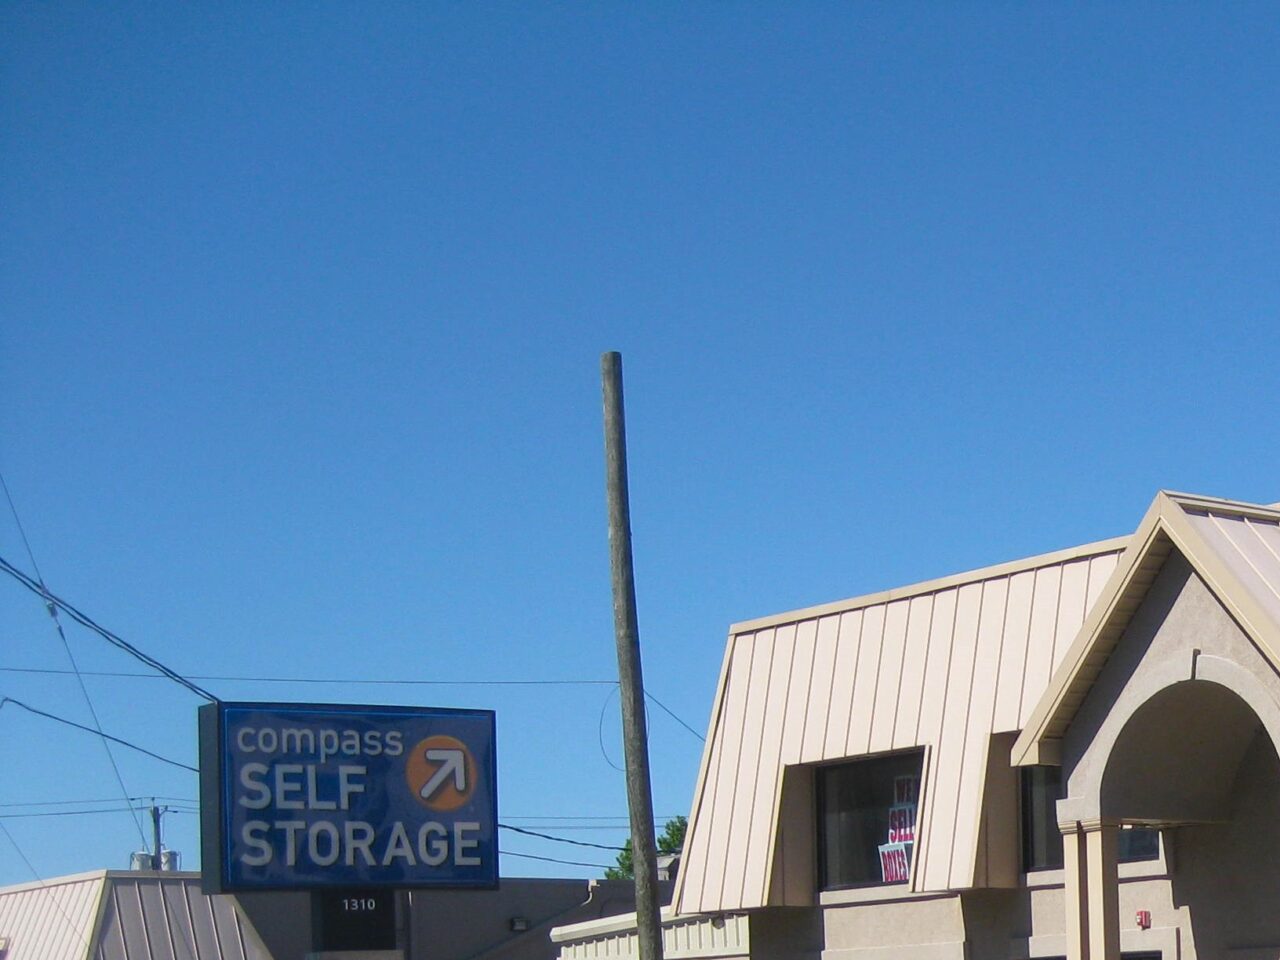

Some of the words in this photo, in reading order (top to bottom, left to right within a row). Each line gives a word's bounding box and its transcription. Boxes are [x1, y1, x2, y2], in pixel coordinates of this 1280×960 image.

[237, 727, 403, 763] compass
[239, 762, 367, 810] SELF
[241, 820, 482, 867] STORAGE
[881, 850, 908, 882] BOXES
[343, 899, 376, 911] 1310
